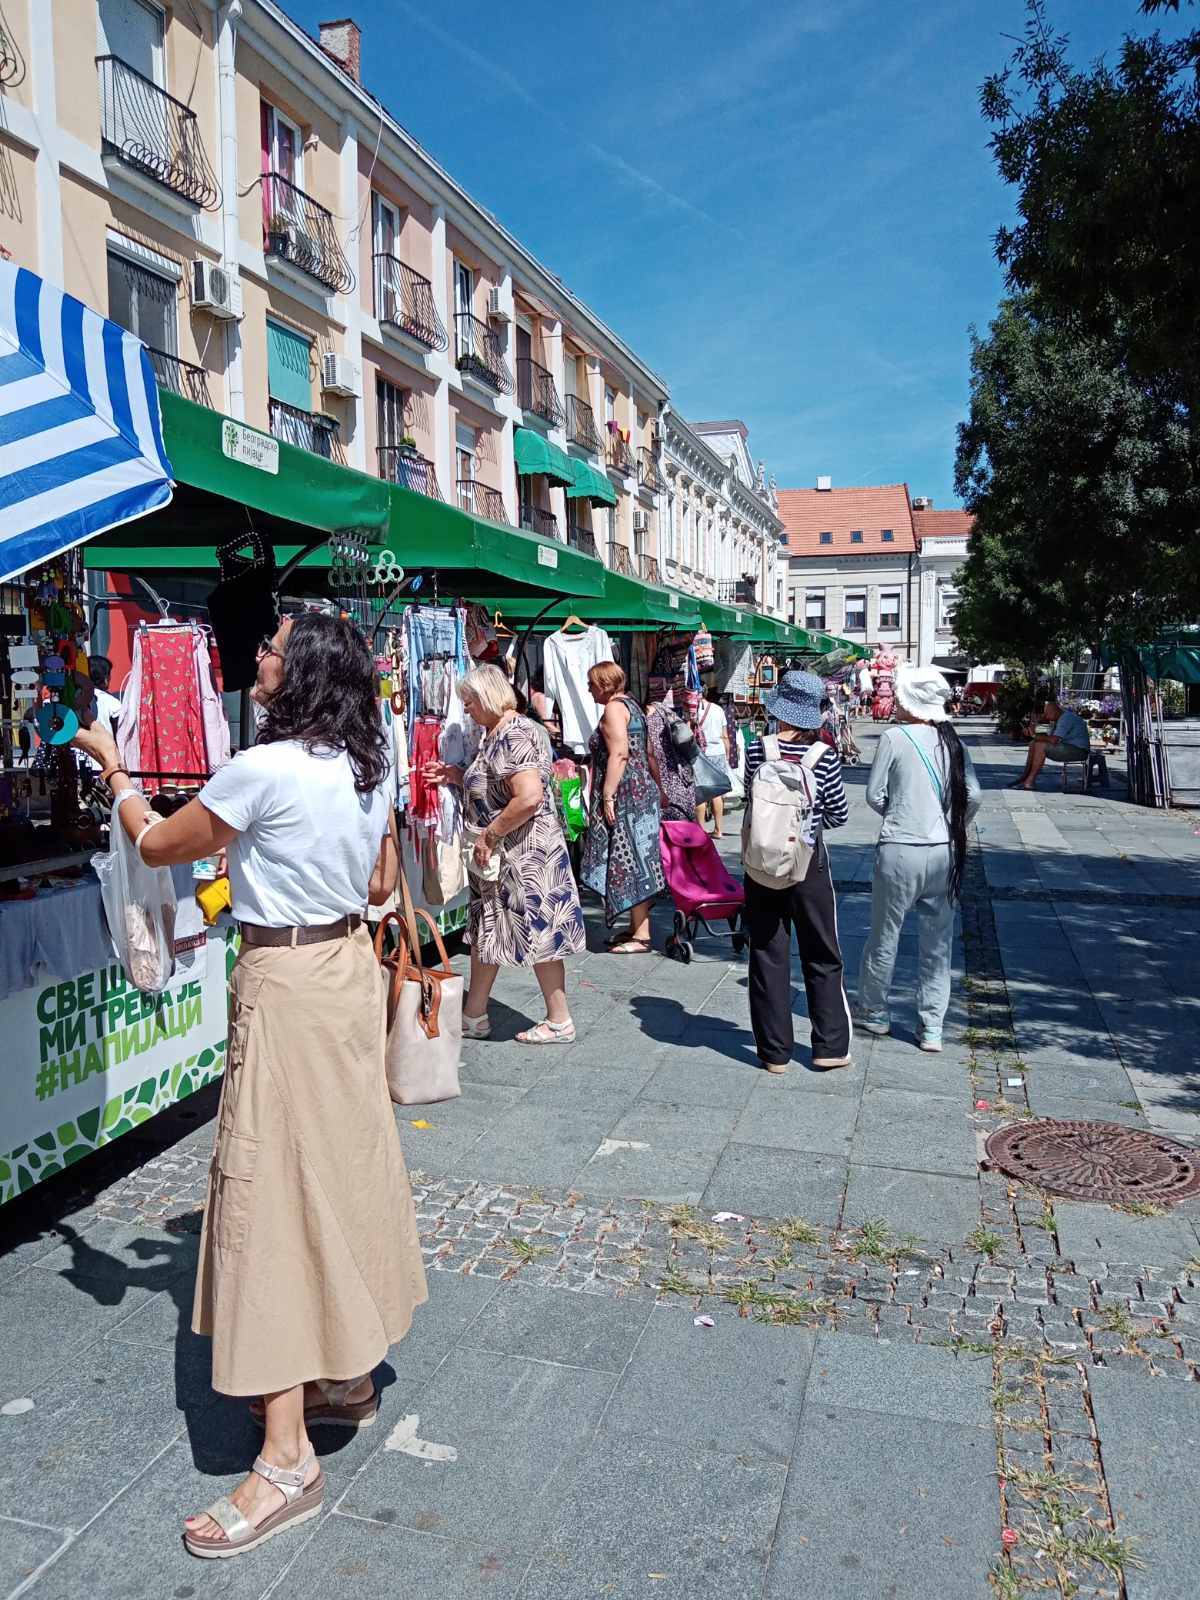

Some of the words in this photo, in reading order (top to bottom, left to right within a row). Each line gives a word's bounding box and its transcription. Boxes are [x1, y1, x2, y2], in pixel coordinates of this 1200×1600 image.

[37, 973, 95, 1024] СВЕ
[39, 1012, 87, 1063] МИ
[90, 990, 174, 1038] ТРЕБА
[177, 980, 202, 1004] ЈЕ
[36, 996, 202, 1101] #НАПИЈАЦИ
